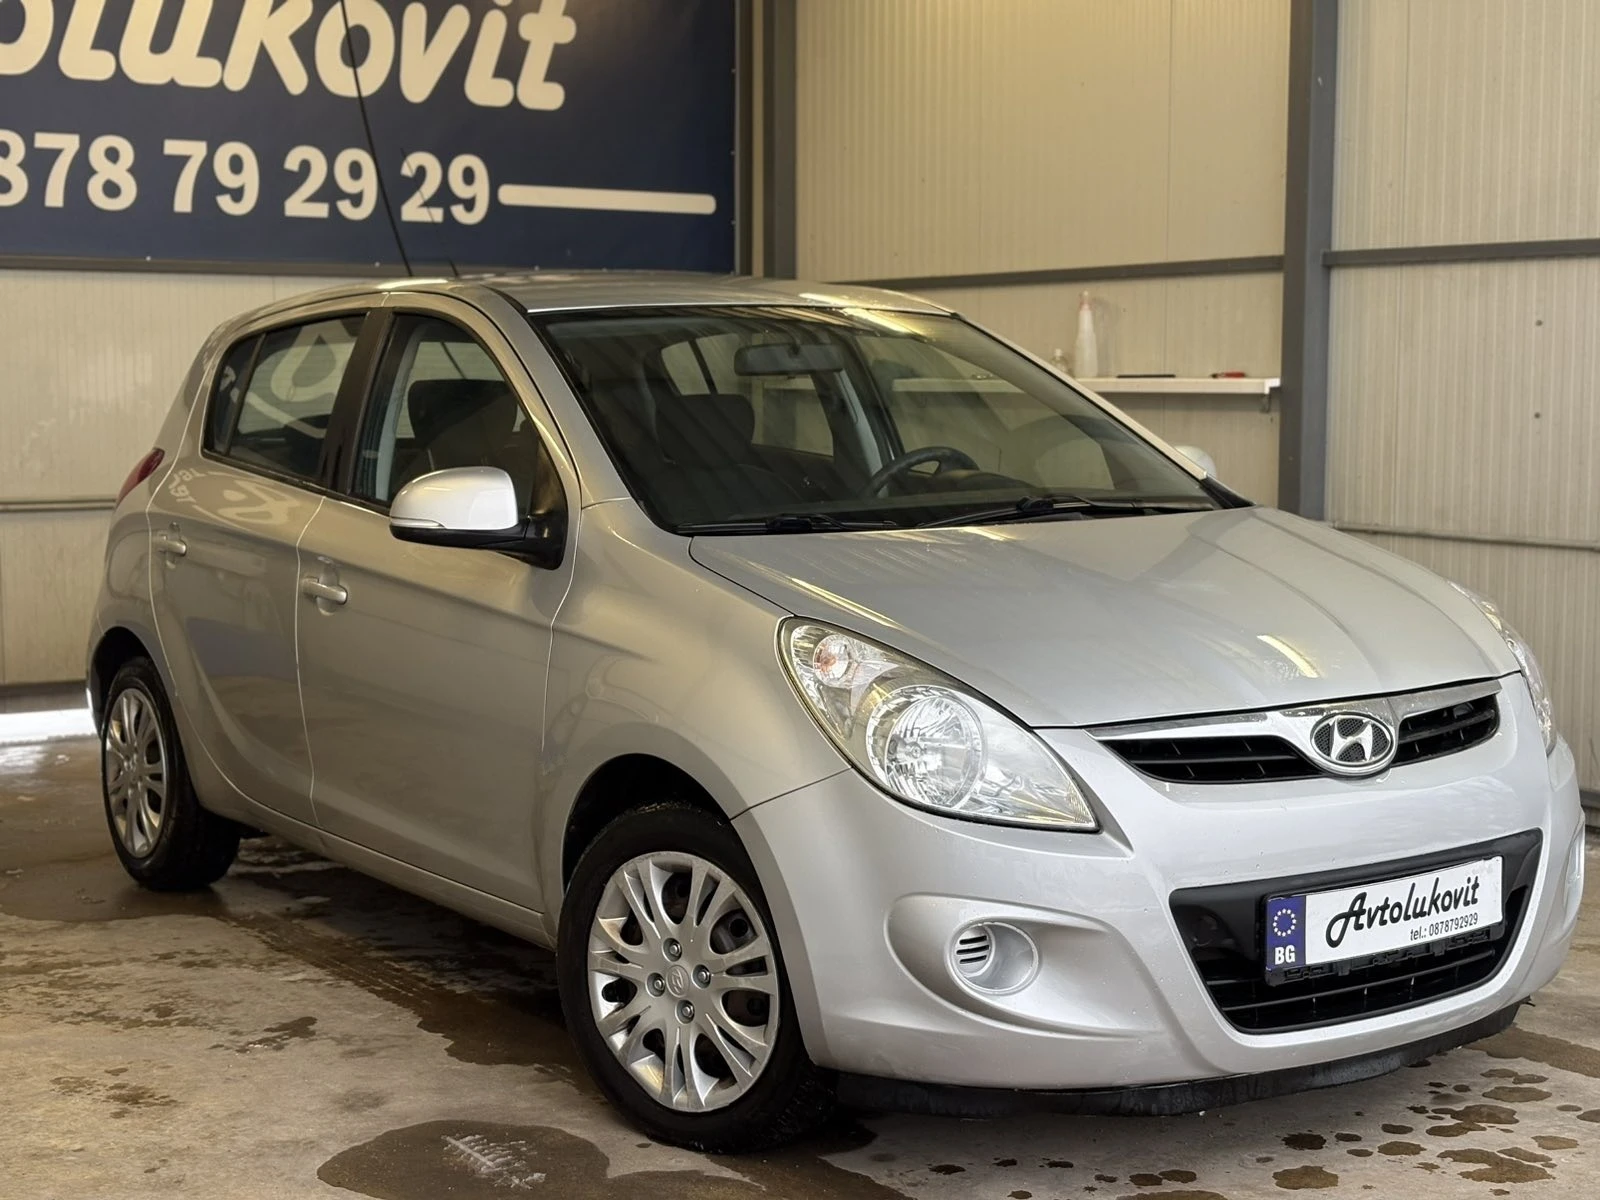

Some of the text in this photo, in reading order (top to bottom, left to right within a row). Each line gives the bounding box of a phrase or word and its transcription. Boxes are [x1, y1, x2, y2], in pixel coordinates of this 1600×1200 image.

[163, 139, 260, 216] 79
[284, 145, 378, 221] 29
[400, 151, 490, 225] 29
[1325, 875, 1480, 949] Avtolukovit
[1410, 912, 1479, 941] tel.: 0878792929
[1274, 945, 1296, 965] BG
